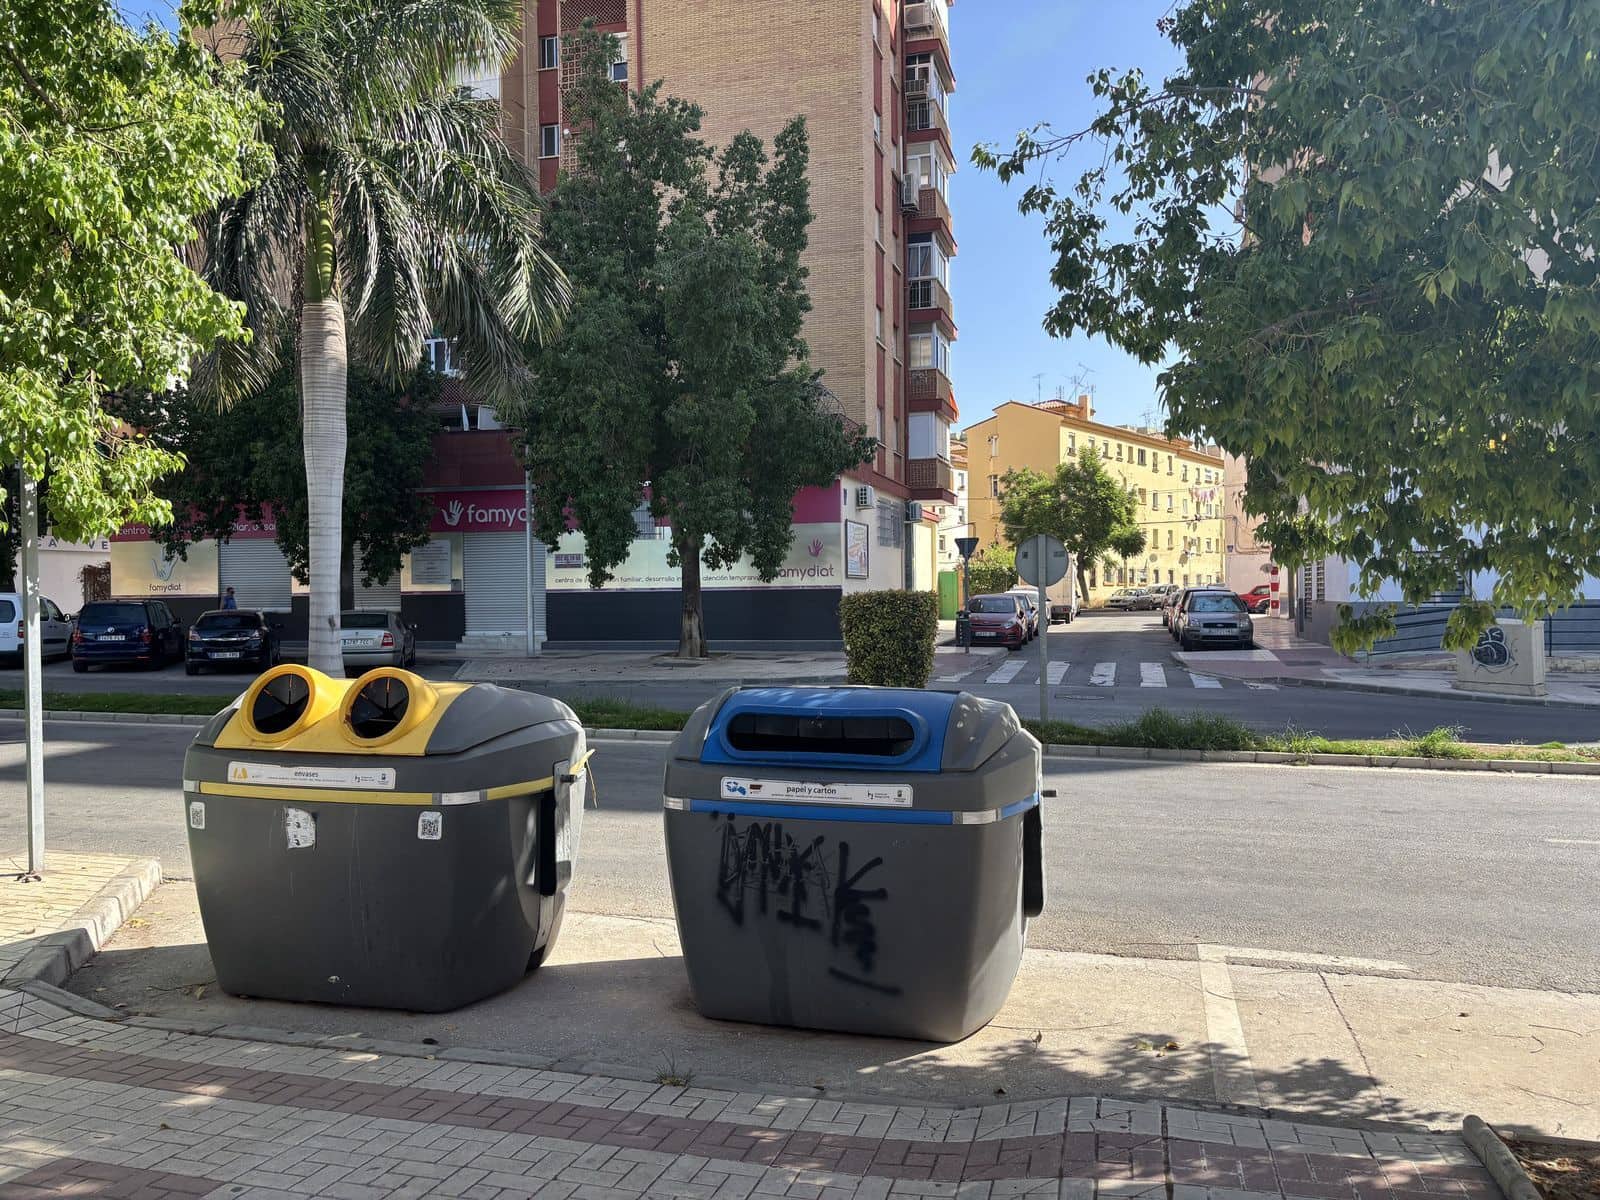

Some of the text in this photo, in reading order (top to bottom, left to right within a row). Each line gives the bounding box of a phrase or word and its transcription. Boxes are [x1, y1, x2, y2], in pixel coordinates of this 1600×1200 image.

[777, 563, 834, 581] amydiat
[149, 583, 181, 593] famydiat
[294, 770, 319, 778] envases
[786, 785, 807, 793] papel
